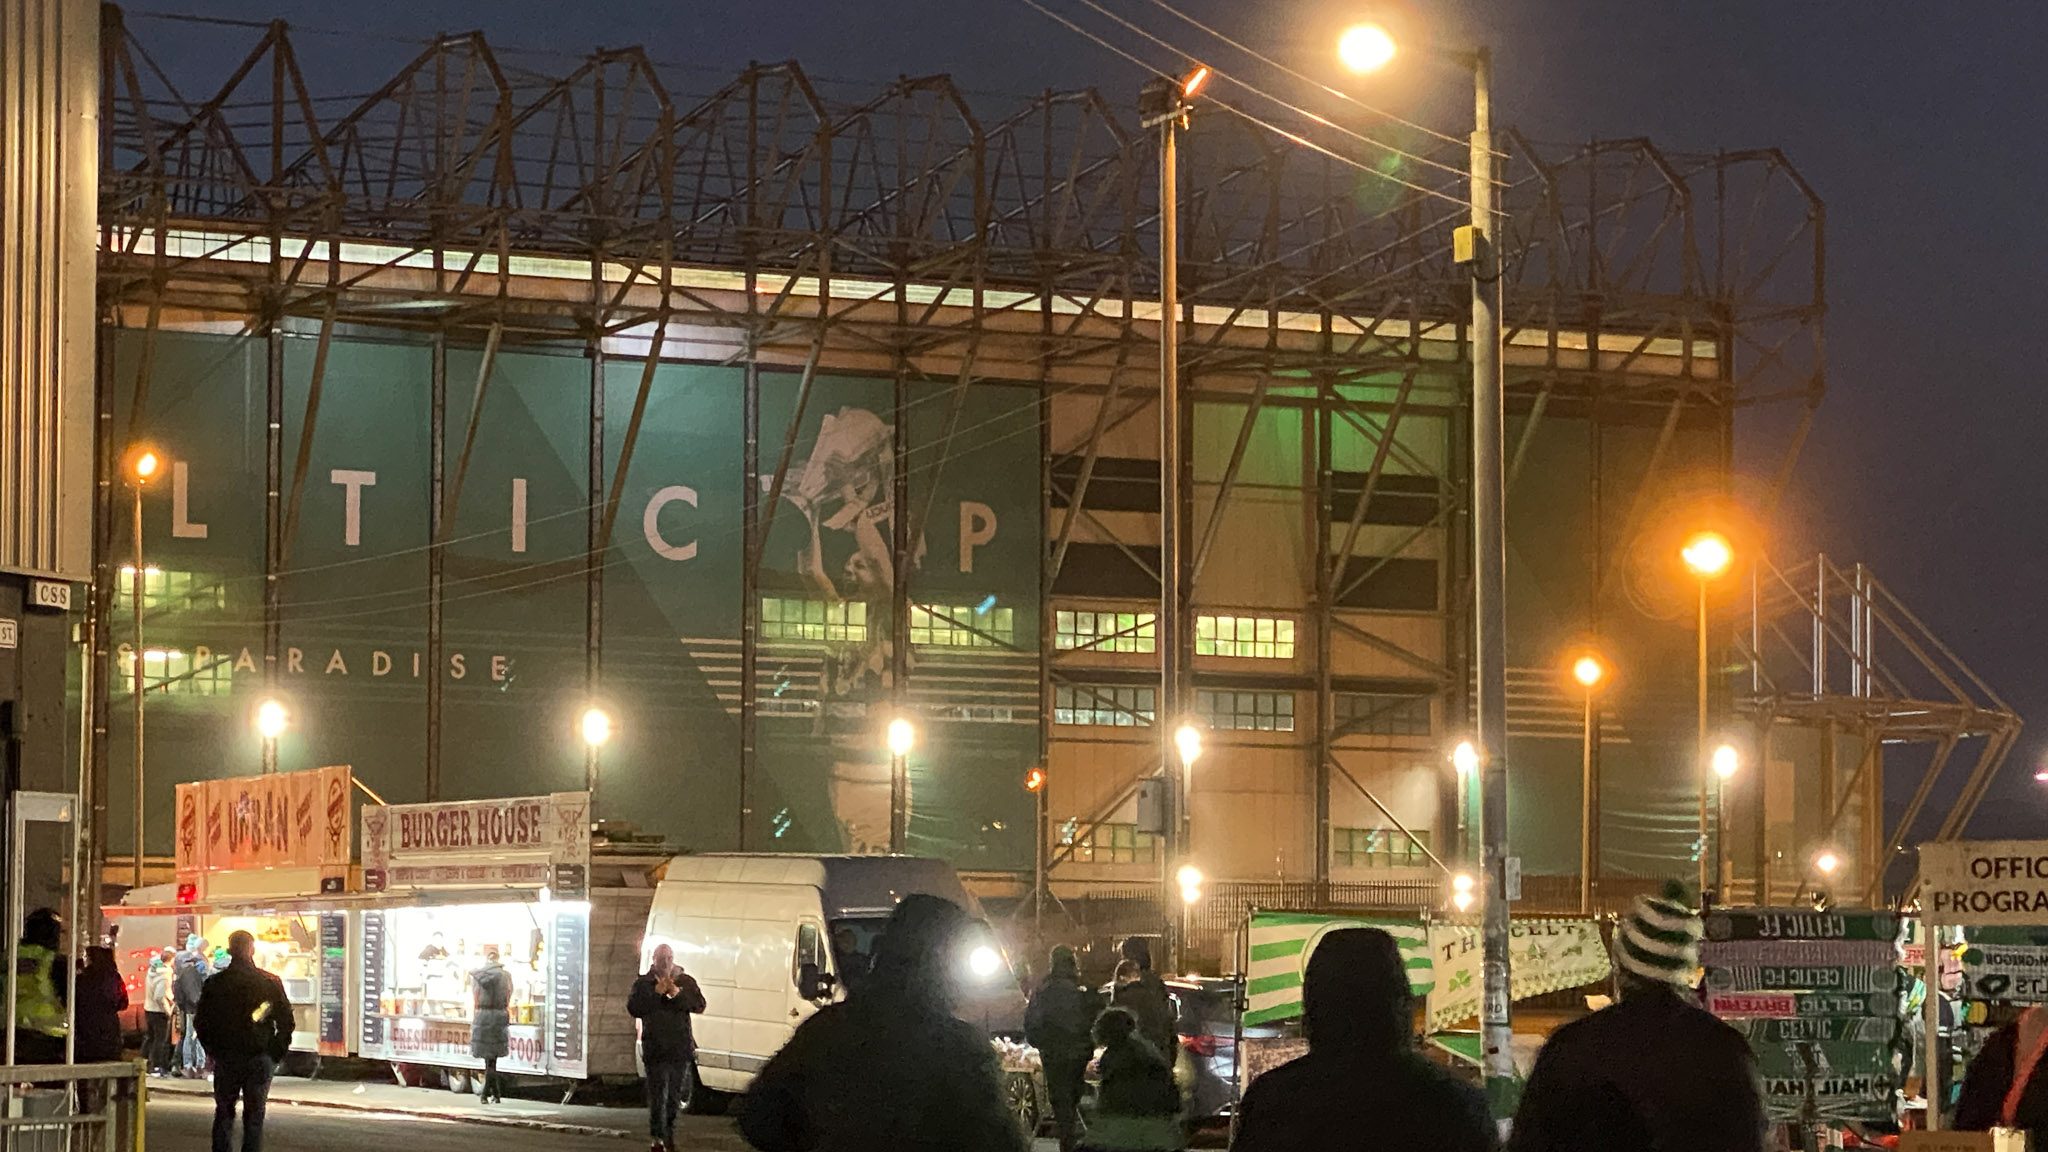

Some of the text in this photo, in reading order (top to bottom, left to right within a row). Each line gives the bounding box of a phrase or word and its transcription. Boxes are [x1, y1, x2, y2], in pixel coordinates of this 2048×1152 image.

[41, 585, 67, 605] CSS
[2, 627, 13, 640] ST
[193, 645, 509, 682] PARADISE
[400, 804, 541, 849] BURGER HOUSE
[1970, 856, 2048, 880] OFFIC
[1933, 890, 2048, 913] PROGRA
[1442, 925, 1576, 963] TH CELT
[1765, 968, 1839, 986] CELTIC FC
[1713, 997, 1864, 1012] CELTIC BAYERN
[1779, 1019, 1832, 1039] CELTIC
[510, 1037, 542, 1063] FOOD
